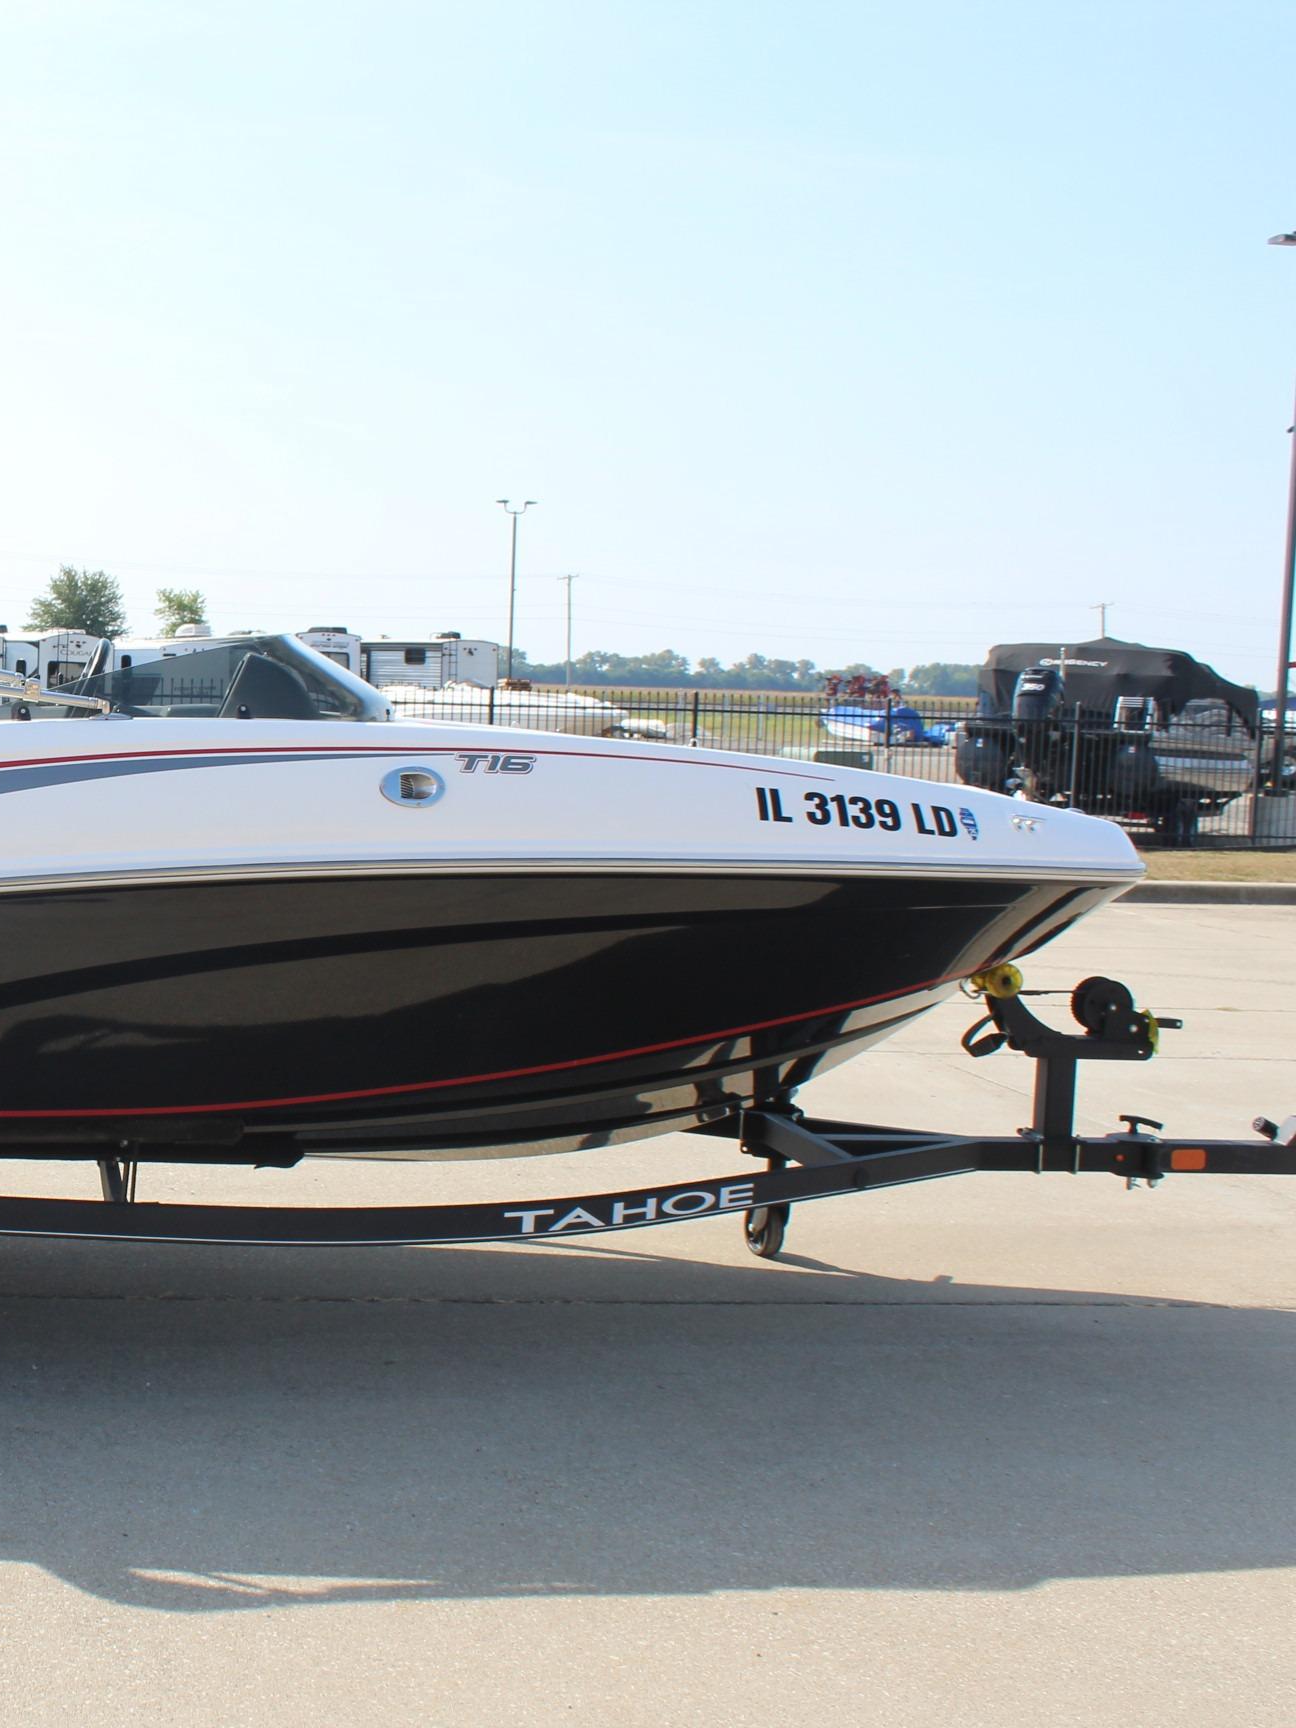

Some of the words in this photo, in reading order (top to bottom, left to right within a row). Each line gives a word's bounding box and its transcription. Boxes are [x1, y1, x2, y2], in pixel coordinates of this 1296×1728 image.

[455, 753, 536, 775] T16
[755, 787, 793, 823] IL
[804, 791, 902, 832] 3139
[911, 803, 958, 838] LD
[504, 1183, 754, 1234] TAHOE
